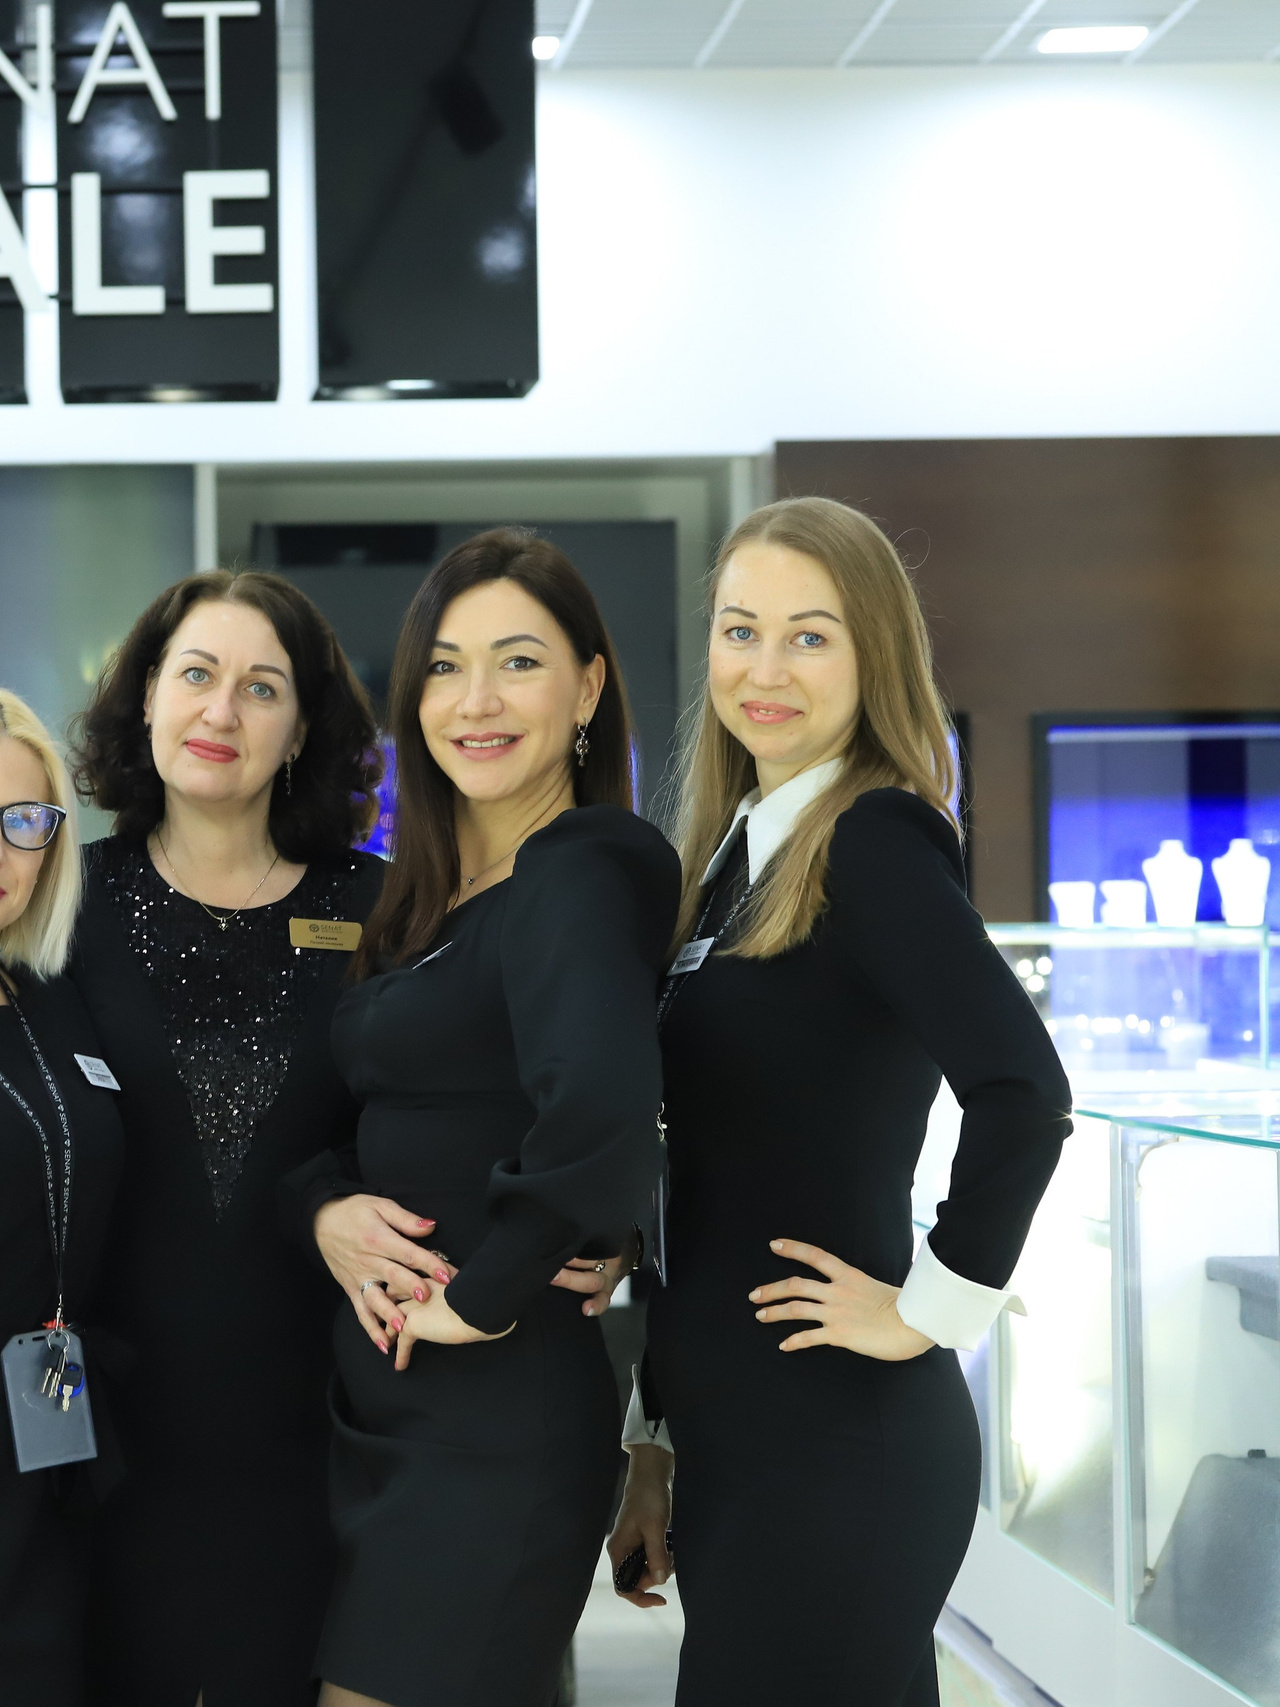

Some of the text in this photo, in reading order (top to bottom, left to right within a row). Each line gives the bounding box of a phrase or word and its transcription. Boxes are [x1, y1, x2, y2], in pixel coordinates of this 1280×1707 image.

[9, 1089, 29, 1109] SENAT
[48, 1082, 62, 1103] SENAT
[32, 1118, 47, 1141] SENAT
[60, 1112, 70, 1137] SENAT
[45, 1154, 53, 1180] SENAT
